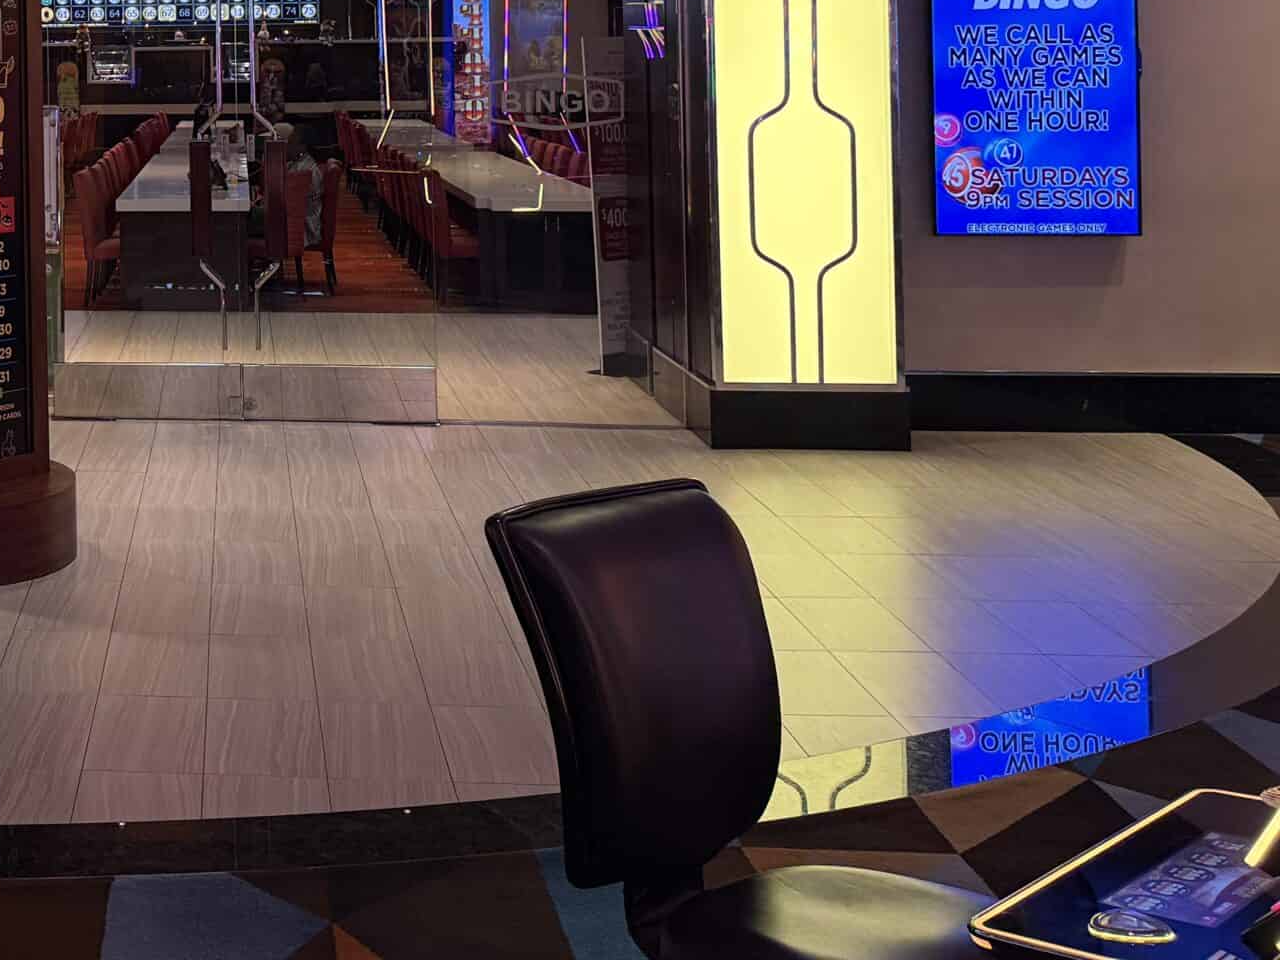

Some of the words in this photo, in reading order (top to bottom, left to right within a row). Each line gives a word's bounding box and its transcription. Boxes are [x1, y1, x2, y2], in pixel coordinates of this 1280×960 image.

[75, 9, 85, 19] 62
[956, 25, 998, 45] WE
[1007, 24, 1072, 44] CALL
[1081, 24, 1113, 44] AS
[950, 46, 1024, 67] MANY
[1033, 46, 1121, 66] GAMES
[962, 68, 996, 88] AS
[1004, 68, 1046, 88] WE
[1054, 67, 1109, 87] CAN
[503, 90, 611, 114] BINGO
[988, 89, 1083, 109] WITHIN
[965, 111, 1019, 131] ONE
[1028, 111, 1109, 131] HOUR!
[971, 167, 1129, 187] SATURDAYS
[966, 190, 1010, 208] 9PM
[1018, 189, 1134, 209] SESSION
[967, 224, 1035, 233] ELECTRONIC
[1037, 224, 1073, 233] GAMES
[1077, 223, 1107, 233] ONLY
[0, 283, 7, 295] 3
[0, 305, 5, 317] 9
[0, 346, 12, 360] 29
[0, 369, 10, 383] 31
